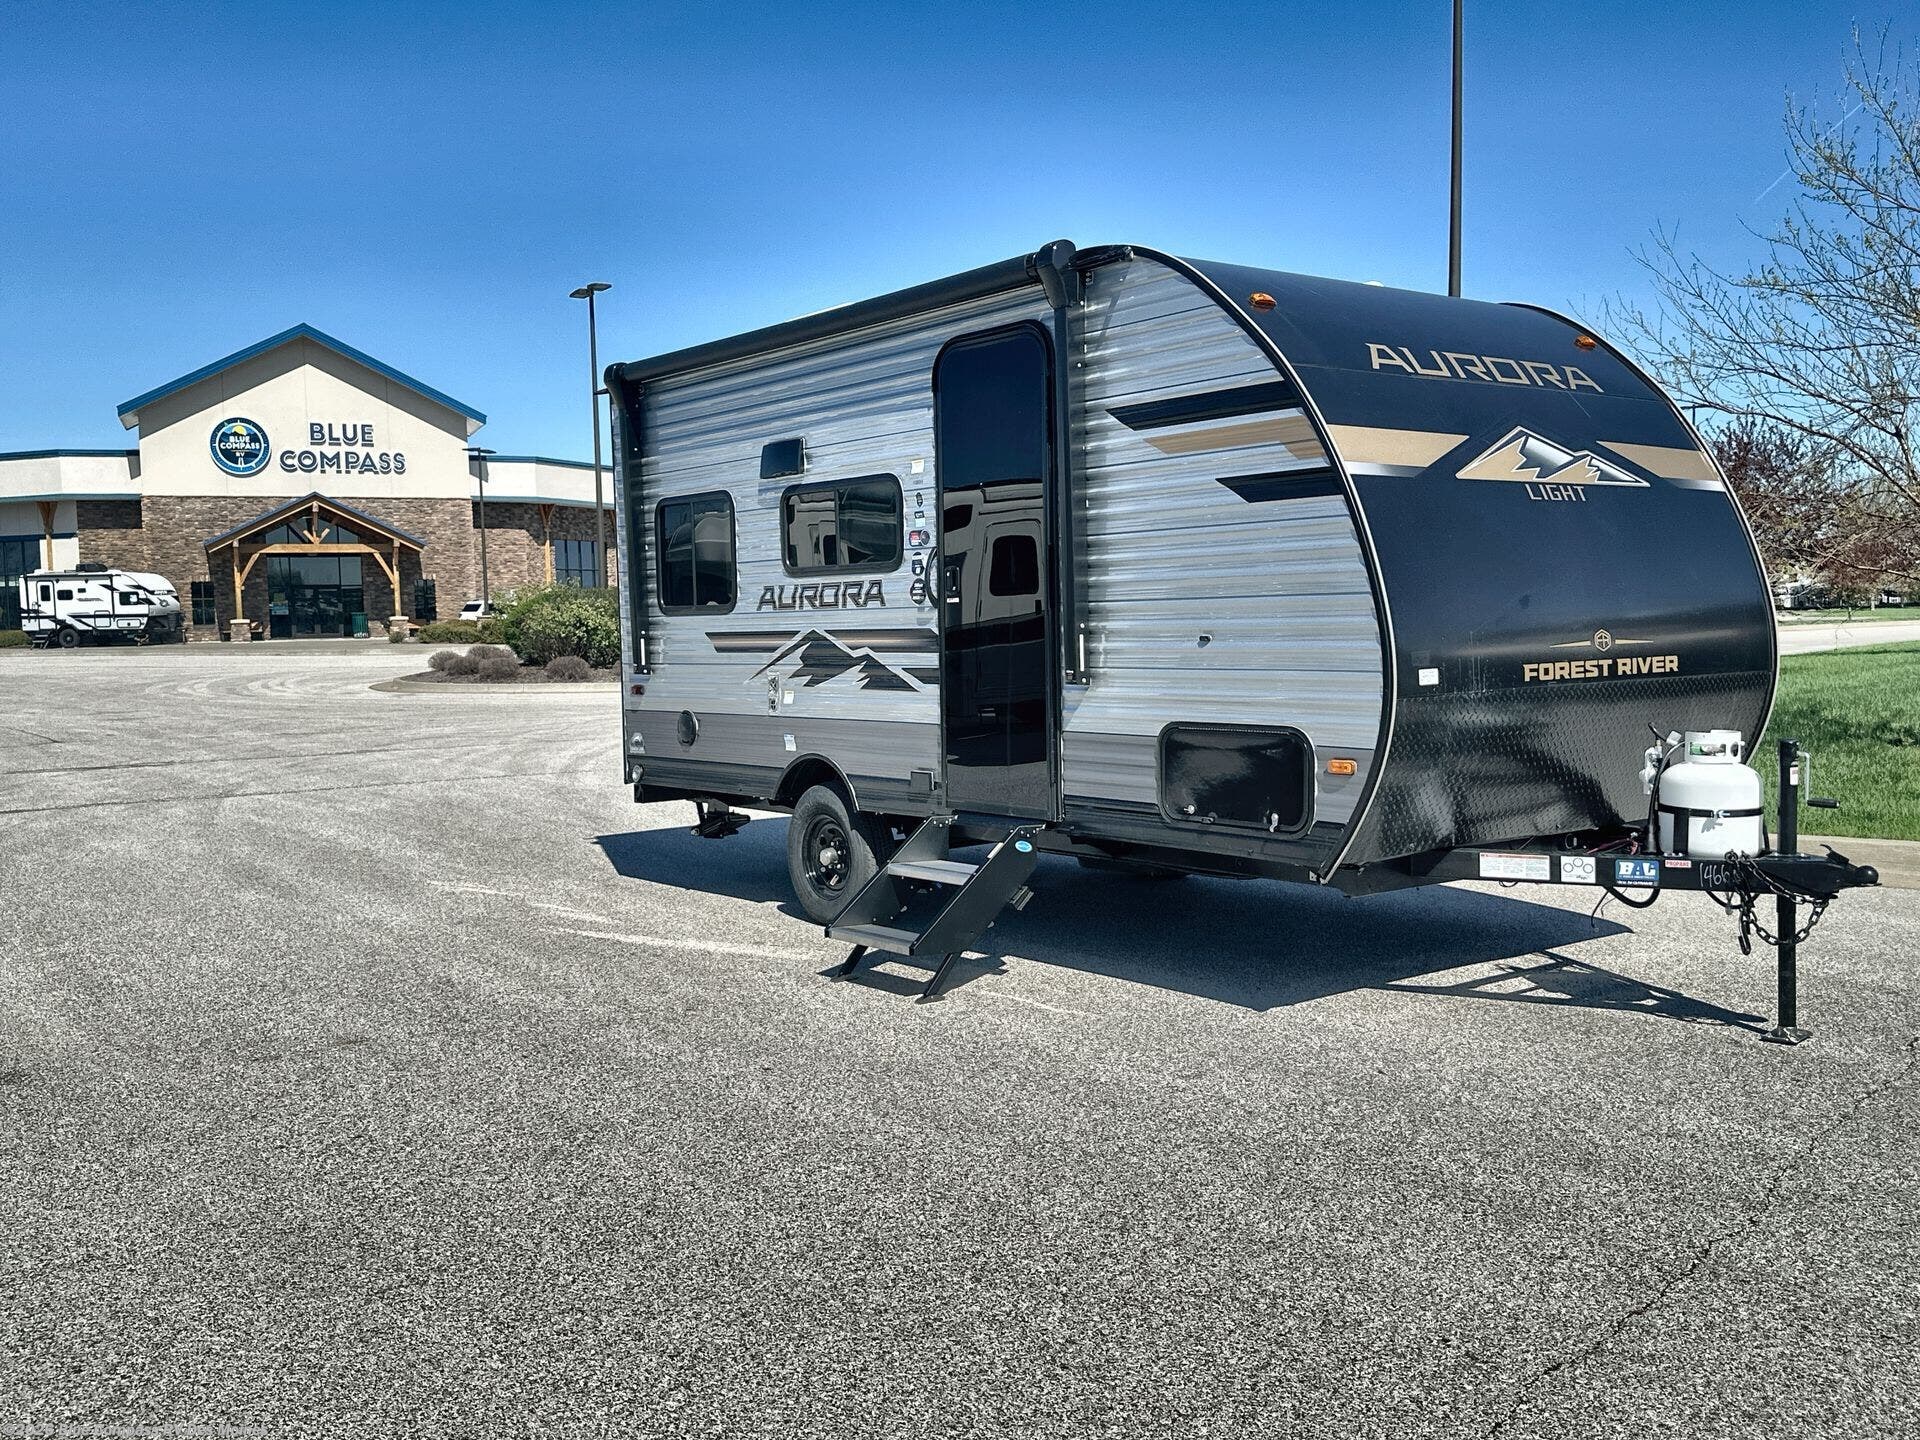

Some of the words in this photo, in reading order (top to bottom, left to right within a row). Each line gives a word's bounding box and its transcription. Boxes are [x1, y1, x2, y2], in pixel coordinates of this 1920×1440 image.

[1365, 342, 1604, 394] AURORA
[220, 442, 260, 450] COMPASS
[229, 435, 251, 443] BLUE
[309, 422, 375, 447] BLUE
[279, 449, 407, 475] COMPASS
[1524, 483, 1588, 502] LIGHT
[756, 579, 886, 611] AURORA
[1522, 659, 1613, 682] FOREST
[1616, 654, 1679, 677] RIVER
